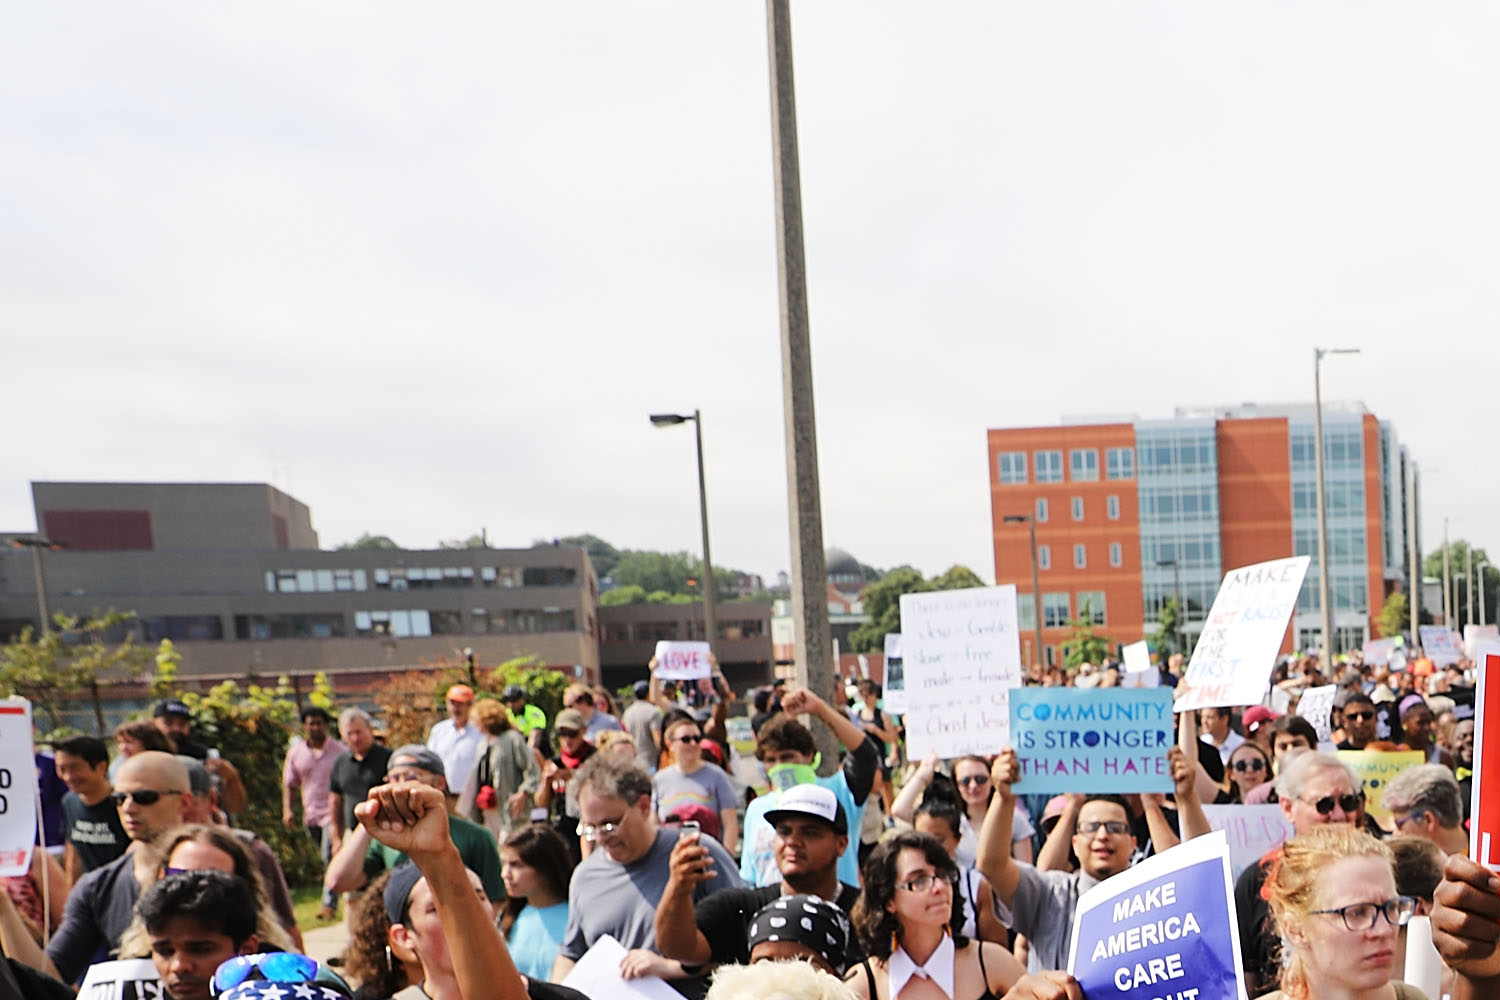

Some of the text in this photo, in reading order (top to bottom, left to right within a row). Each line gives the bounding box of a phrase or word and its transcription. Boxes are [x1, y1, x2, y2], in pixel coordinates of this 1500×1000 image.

[1228, 563, 1298, 590] MAKE
[663, 650, 699, 671] LOVE
[1184, 683, 1235, 705] TIME
[1017, 702, 1166, 722] COMMUNITY
[1017, 729, 1168, 749] IS STRONGER
[1019, 757, 1167, 776] THAN HATE
[1112, 882, 1176, 924] MAKE
[1091, 912, 1201, 963] AMERICA
[1114, 954, 1185, 992] CARE
